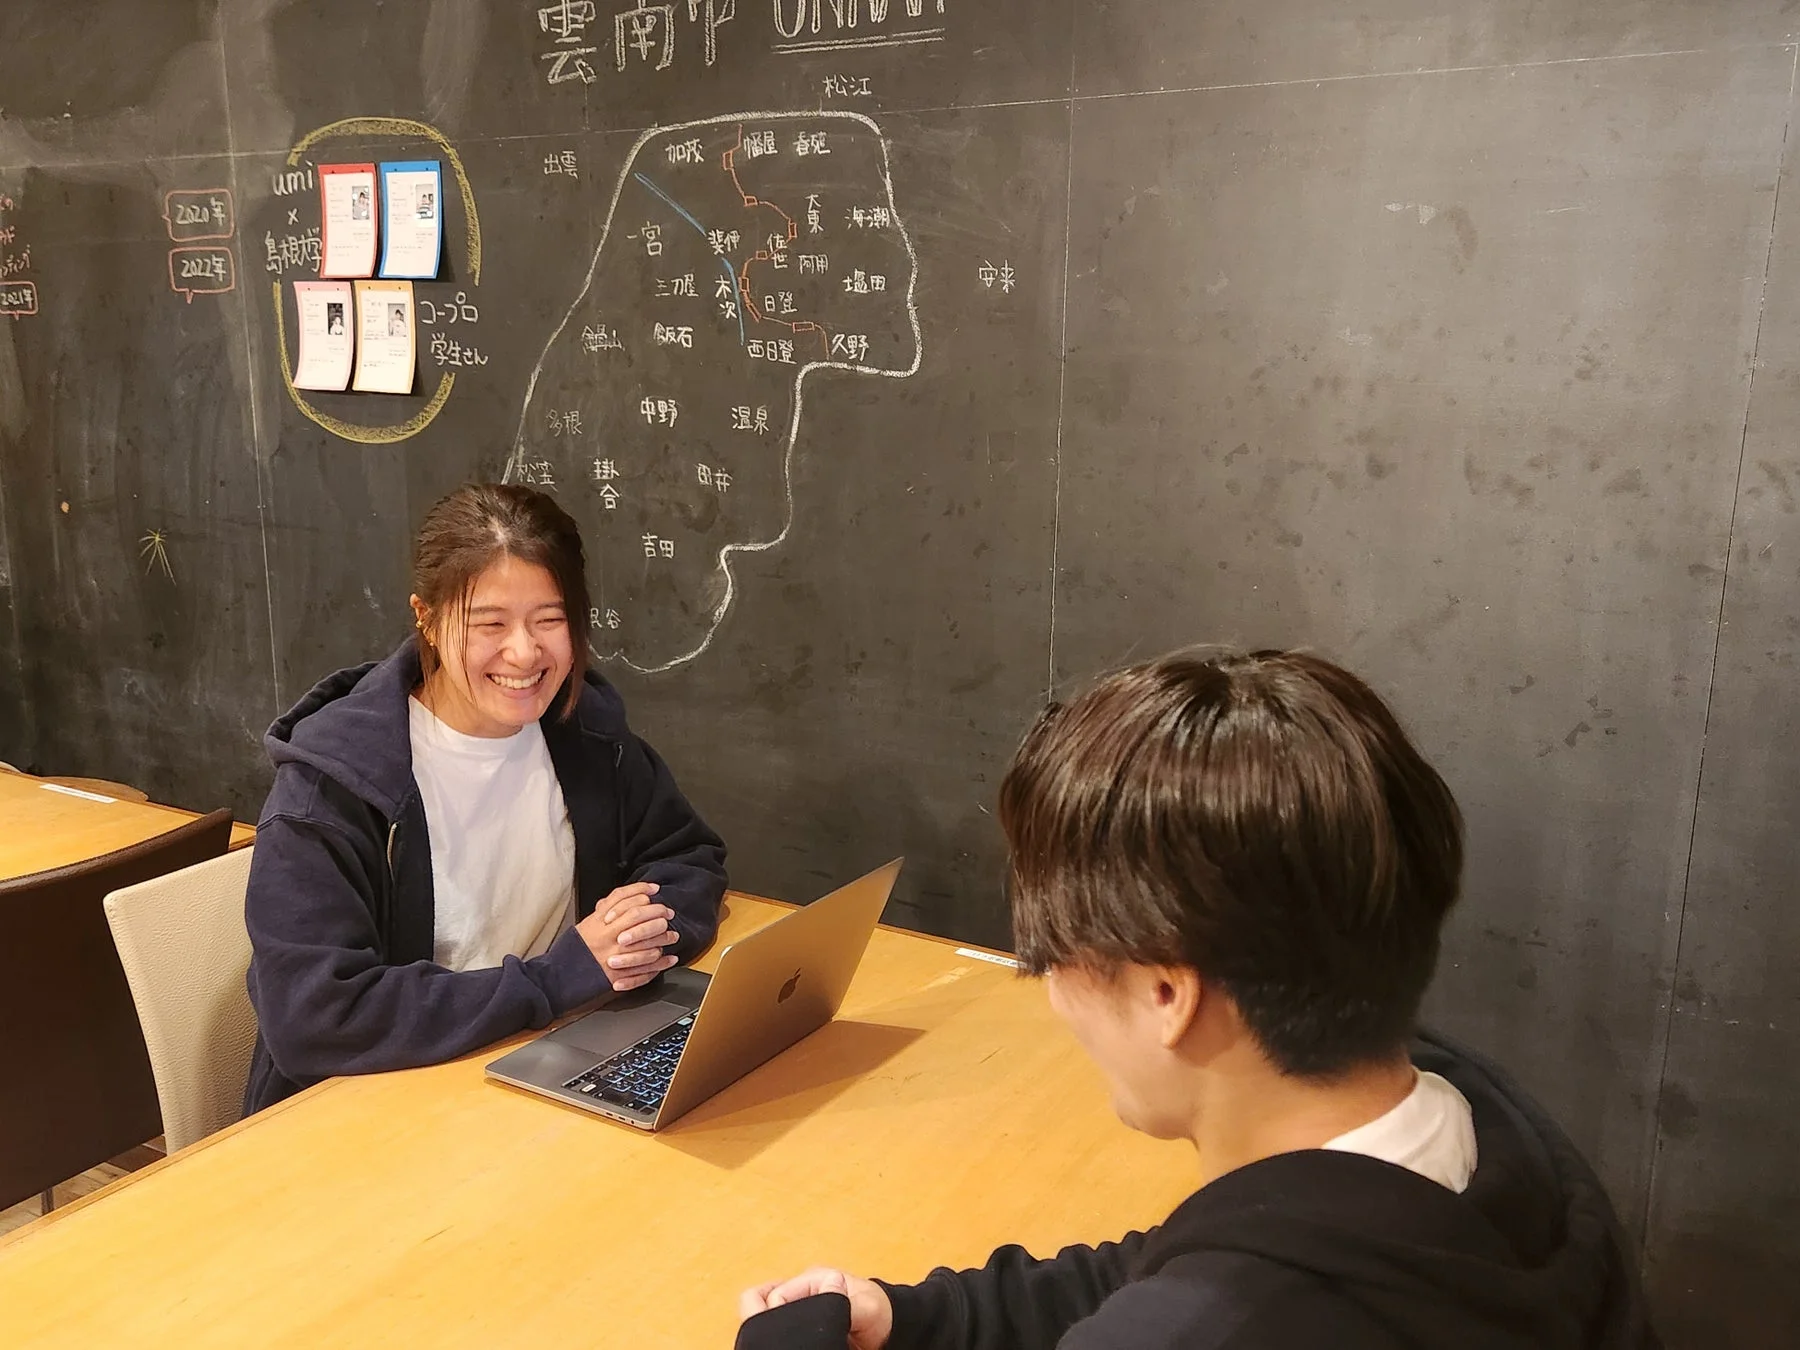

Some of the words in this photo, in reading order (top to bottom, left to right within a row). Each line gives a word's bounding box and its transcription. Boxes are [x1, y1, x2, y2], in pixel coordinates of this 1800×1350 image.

[823, 73, 871, 97] 松江
[666, 138, 704, 163] 加茂
[743, 130, 778, 160] 幡屋
[272, 160, 314, 196] umi
[544, 150, 579, 179] 出雲
[175, 197, 226, 226] 2020年
[804, 193, 824, 235] 大東
[843, 204, 892, 230] 海潮
[264, 229, 323, 274] 島根大学
[626, 221, 662, 256] 一宮
[707, 227, 741, 255] 斐伊
[767, 233, 788, 269] 佐世
[181, 254, 227, 281] 2022年
[798, 254, 829, 275] 阿用
[978, 259, 1016, 293] 安来
[655, 273, 699, 298] 三刀屋
[714, 275, 738, 319] 木次
[420, 291, 479, 324] コープロ
[764, 290, 798, 314] 日登
[430, 332, 489, 366] 学生さん
[653, 321, 693, 348] 飯石
[830, 333, 870, 362] 久野
[747, 338, 798, 364] 西日登
[546, 409, 583, 437] 多根
[640, 396, 678, 428] 中野
[731, 405, 769, 436] 温泉
[593, 457, 621, 509] 掛合
[641, 531, 675, 559] 吉田
